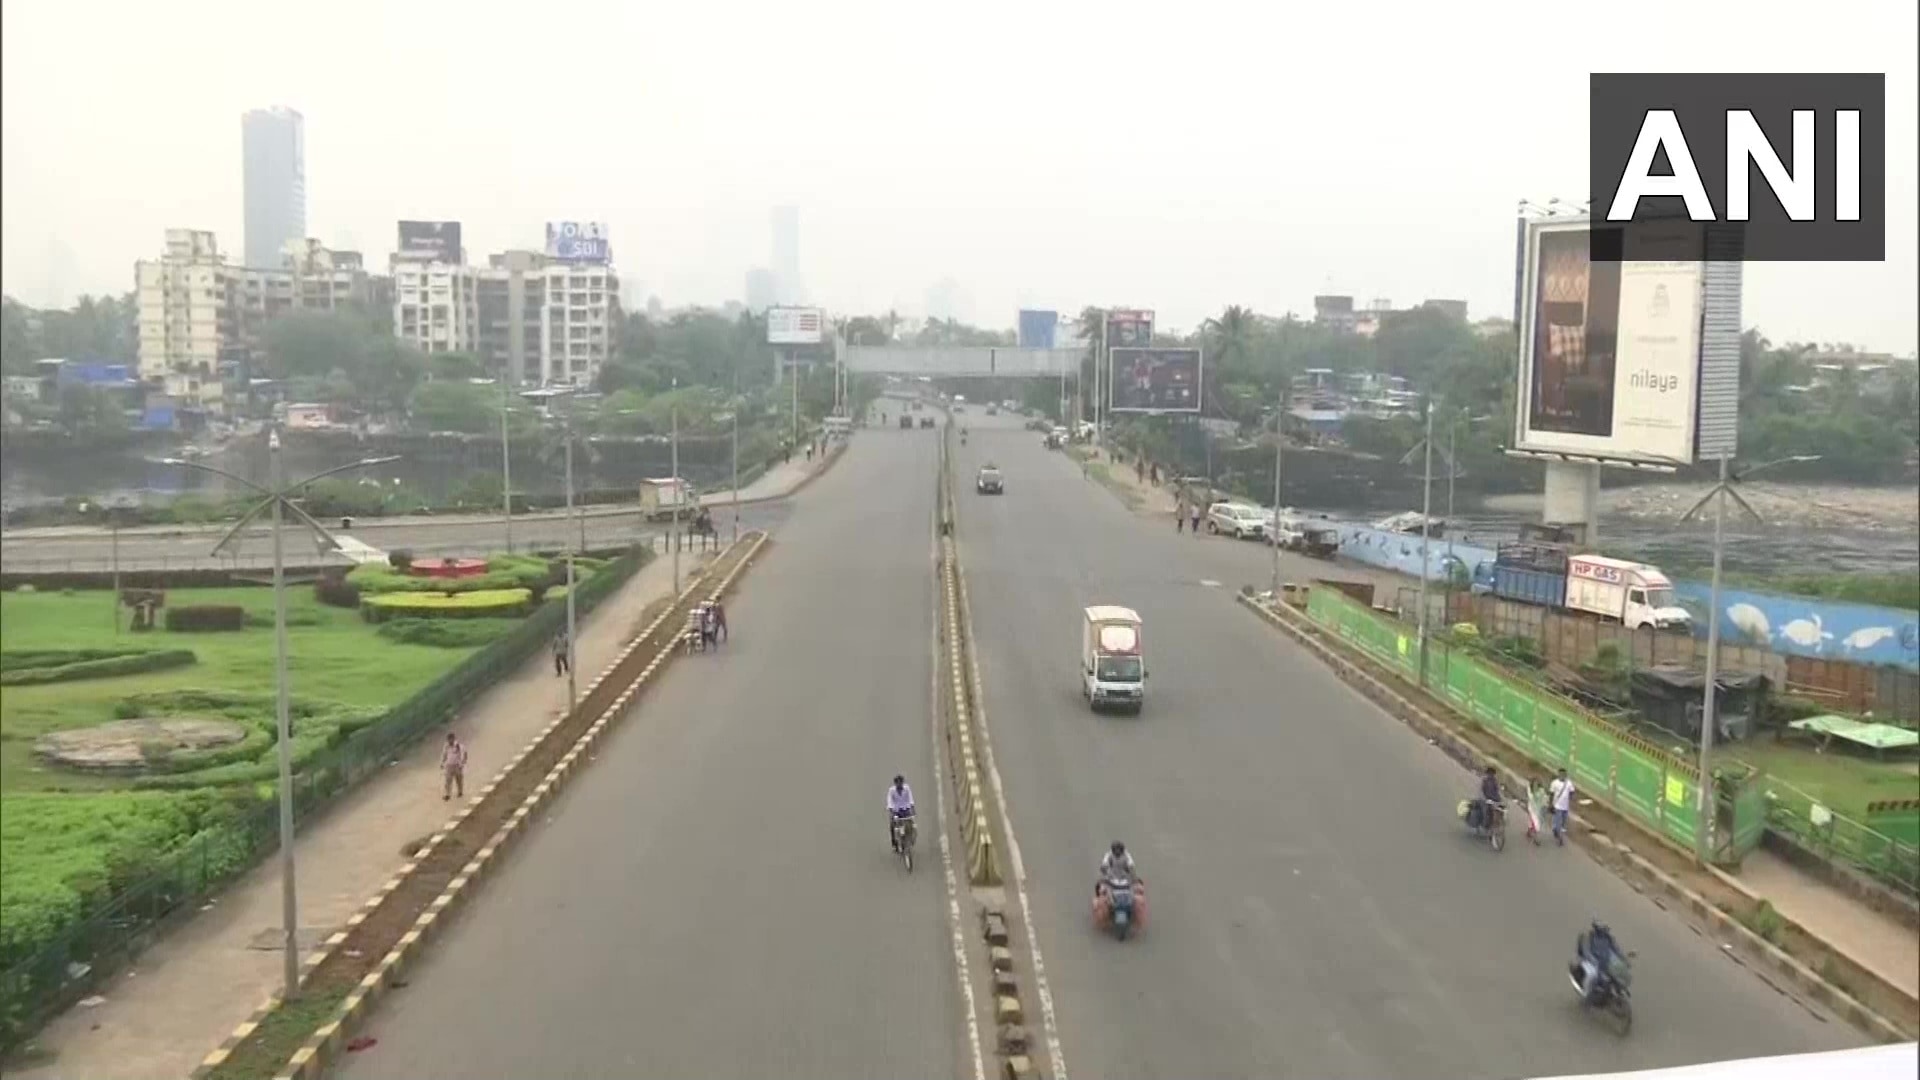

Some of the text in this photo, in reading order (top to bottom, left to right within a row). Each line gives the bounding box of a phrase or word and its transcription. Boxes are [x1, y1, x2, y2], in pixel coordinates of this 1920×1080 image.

[1630, 370, 1679, 392] nilaya
[1575, 563, 1618, 581] HP GAS
